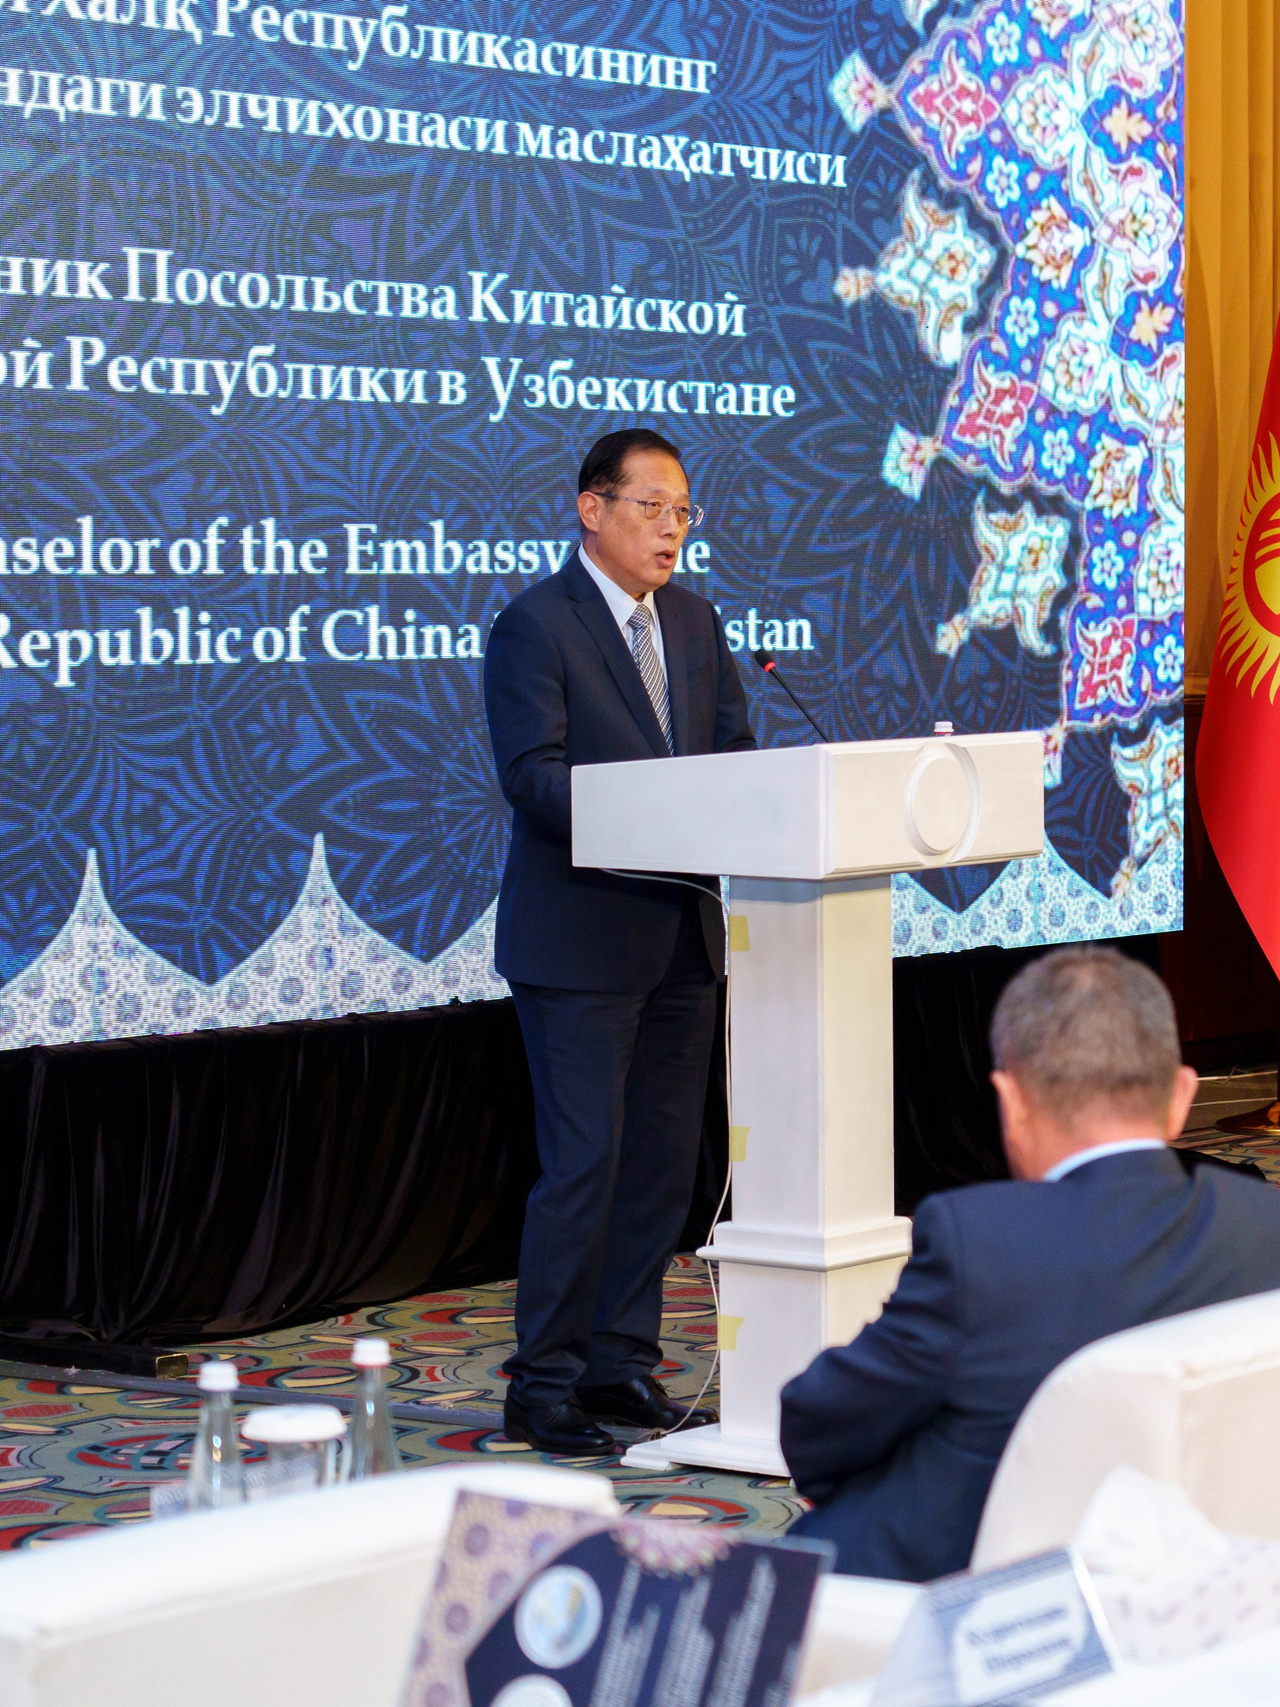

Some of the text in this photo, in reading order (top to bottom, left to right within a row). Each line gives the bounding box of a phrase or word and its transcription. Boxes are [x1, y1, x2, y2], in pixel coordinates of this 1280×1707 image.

[211, 0, 717, 94] Республикасининг
[175, 86, 509, 155] элчихонаси
[513, 120, 849, 188] маслаҳатчиси
[121, 247, 460, 321] Посольства
[467, 270, 747, 337] Китайской
[65, 335, 428, 416] Республики
[437, 370, 468, 405] в
[481, 357, 796, 423] Узбекистане
[168, 517, 229, 575] of
[239, 517, 328, 575] the
[343, 519, 572, 575] Embassy
[252, 605, 310, 663] of
[321, 604, 485, 662] China
